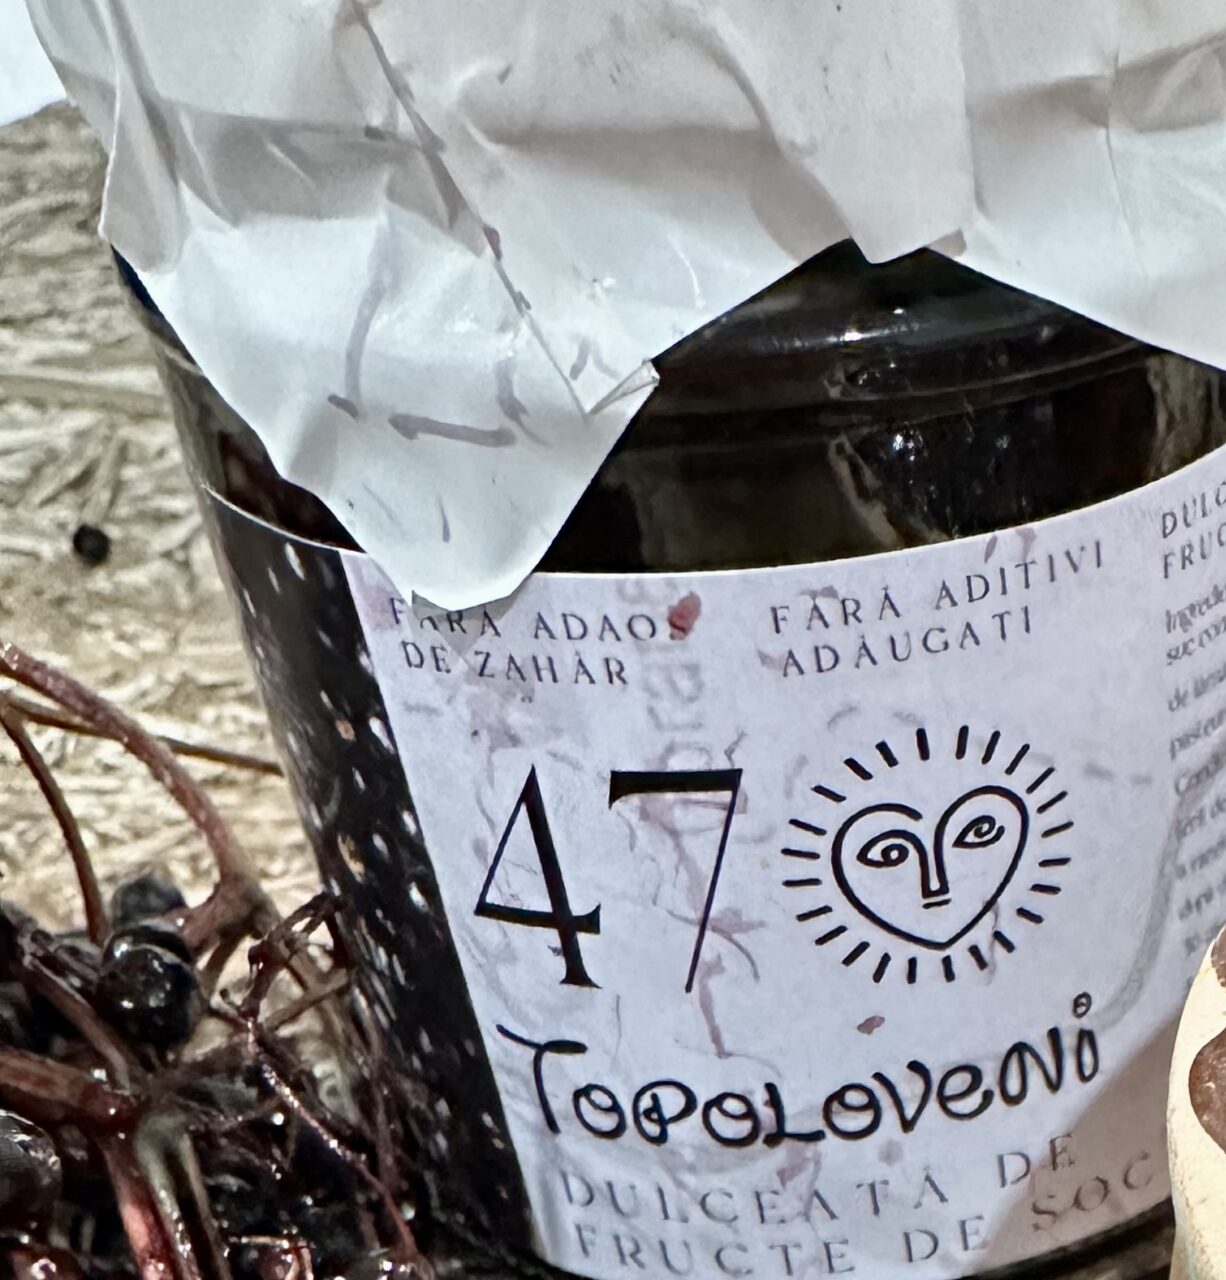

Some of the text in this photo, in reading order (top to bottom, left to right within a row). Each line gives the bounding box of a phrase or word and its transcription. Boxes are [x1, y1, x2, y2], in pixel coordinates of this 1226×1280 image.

[933, 539, 1103, 611] ADITIVI
[401, 640, 452, 675] DE
[474, 762, 744, 994] 47
[996, 1132, 1076, 1189] DE
[573, 1150, 1151, 1278] FRUCTE DE SOC
